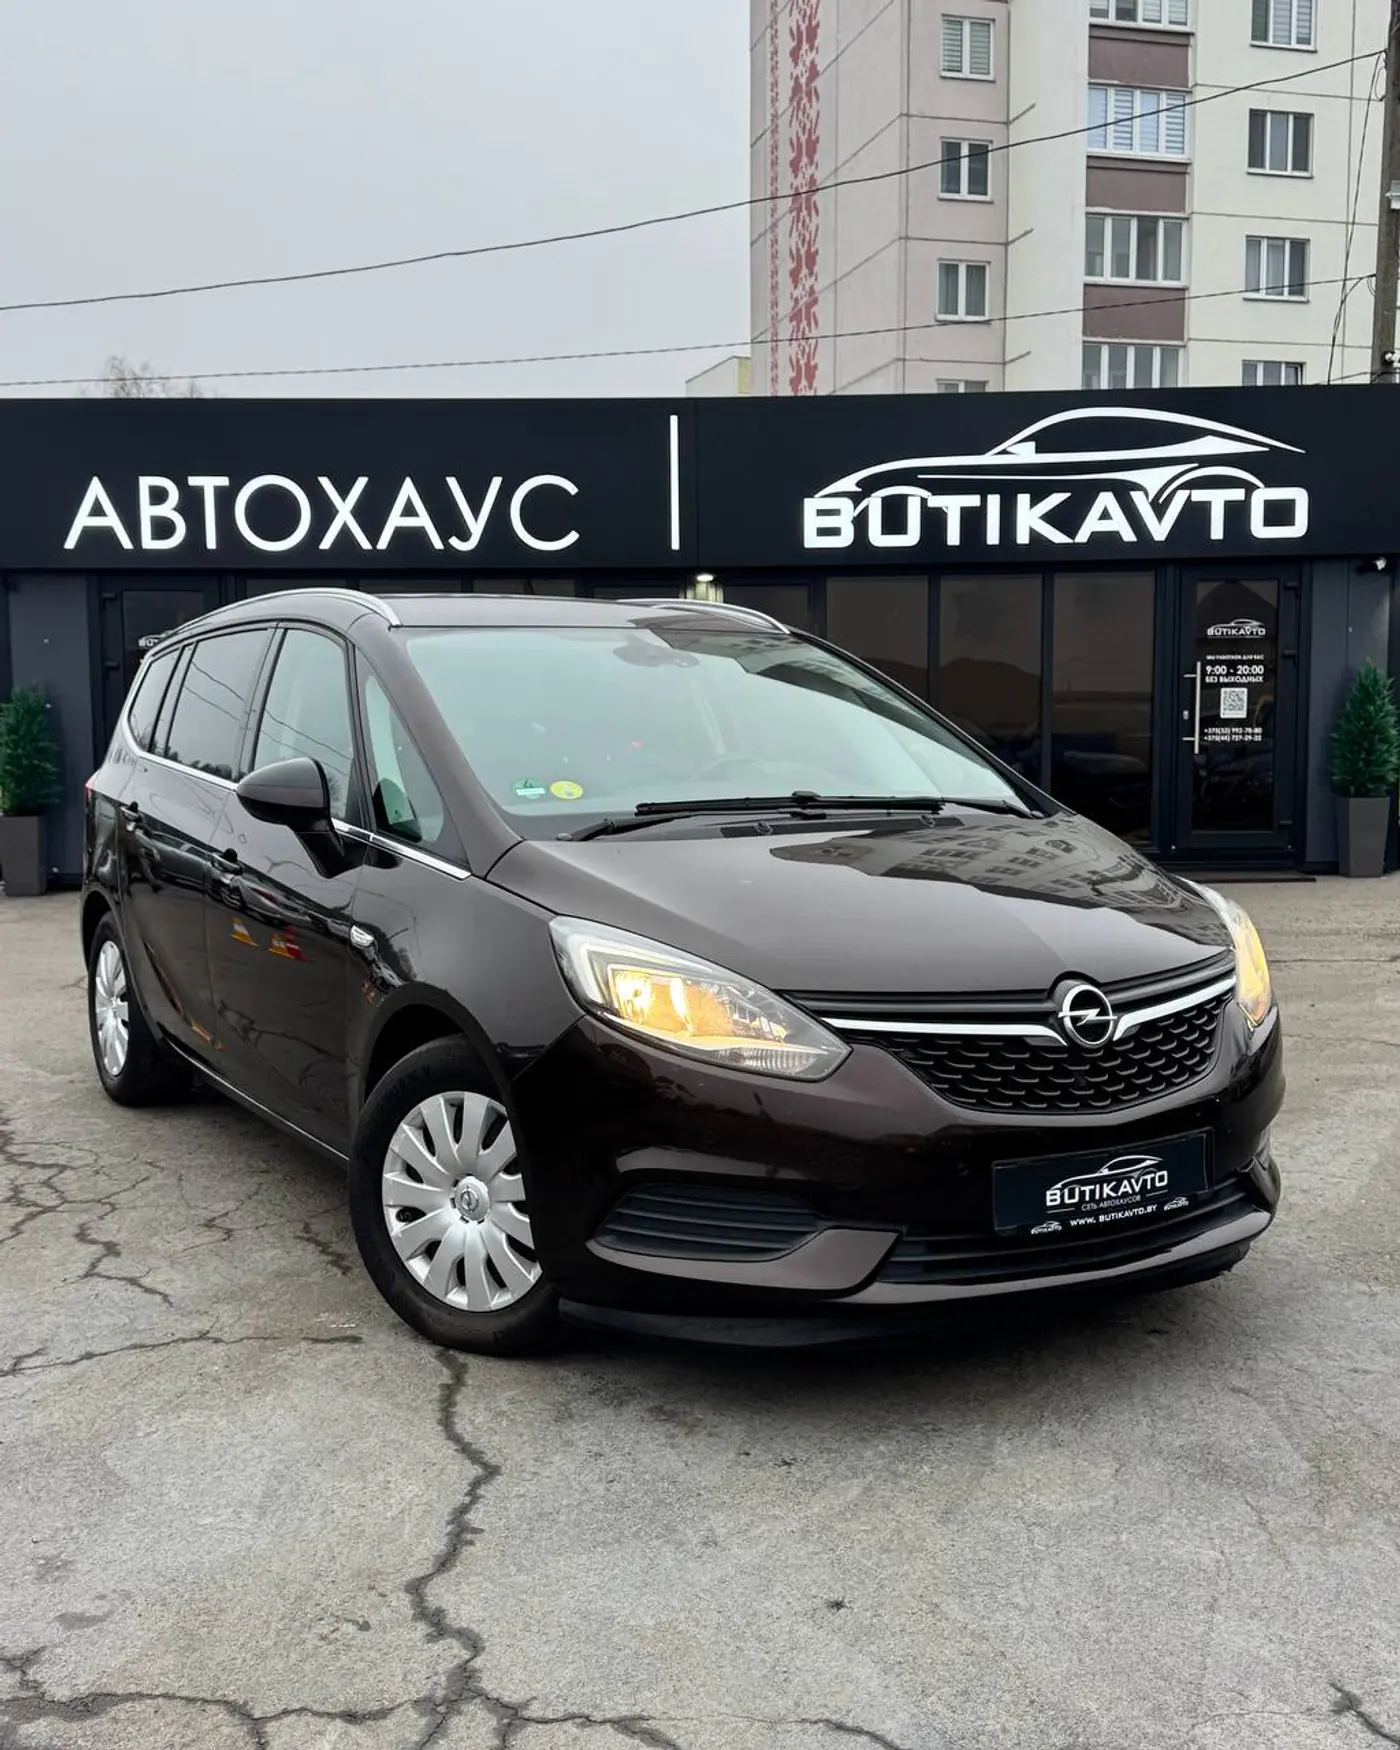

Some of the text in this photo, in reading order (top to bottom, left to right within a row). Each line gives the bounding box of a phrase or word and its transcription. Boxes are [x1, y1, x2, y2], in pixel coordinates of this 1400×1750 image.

[64, 474, 580, 552] АВТОХАУС
[803, 486, 1309, 548] BUTIKAVTO
[1207, 627, 1266, 636] BUTIKAVTO
[1206, 665, 1227, 675] 9:00
[1236, 665, 1264, 675] 20:00
[1046, 1170, 1169, 1206] BUTIKAVTO
[1081, 1195, 1142, 1212] СЕТЬ АВТОХАУСОВ
[1099, 1204, 1158, 1223] BUTIKAVTO.BY
